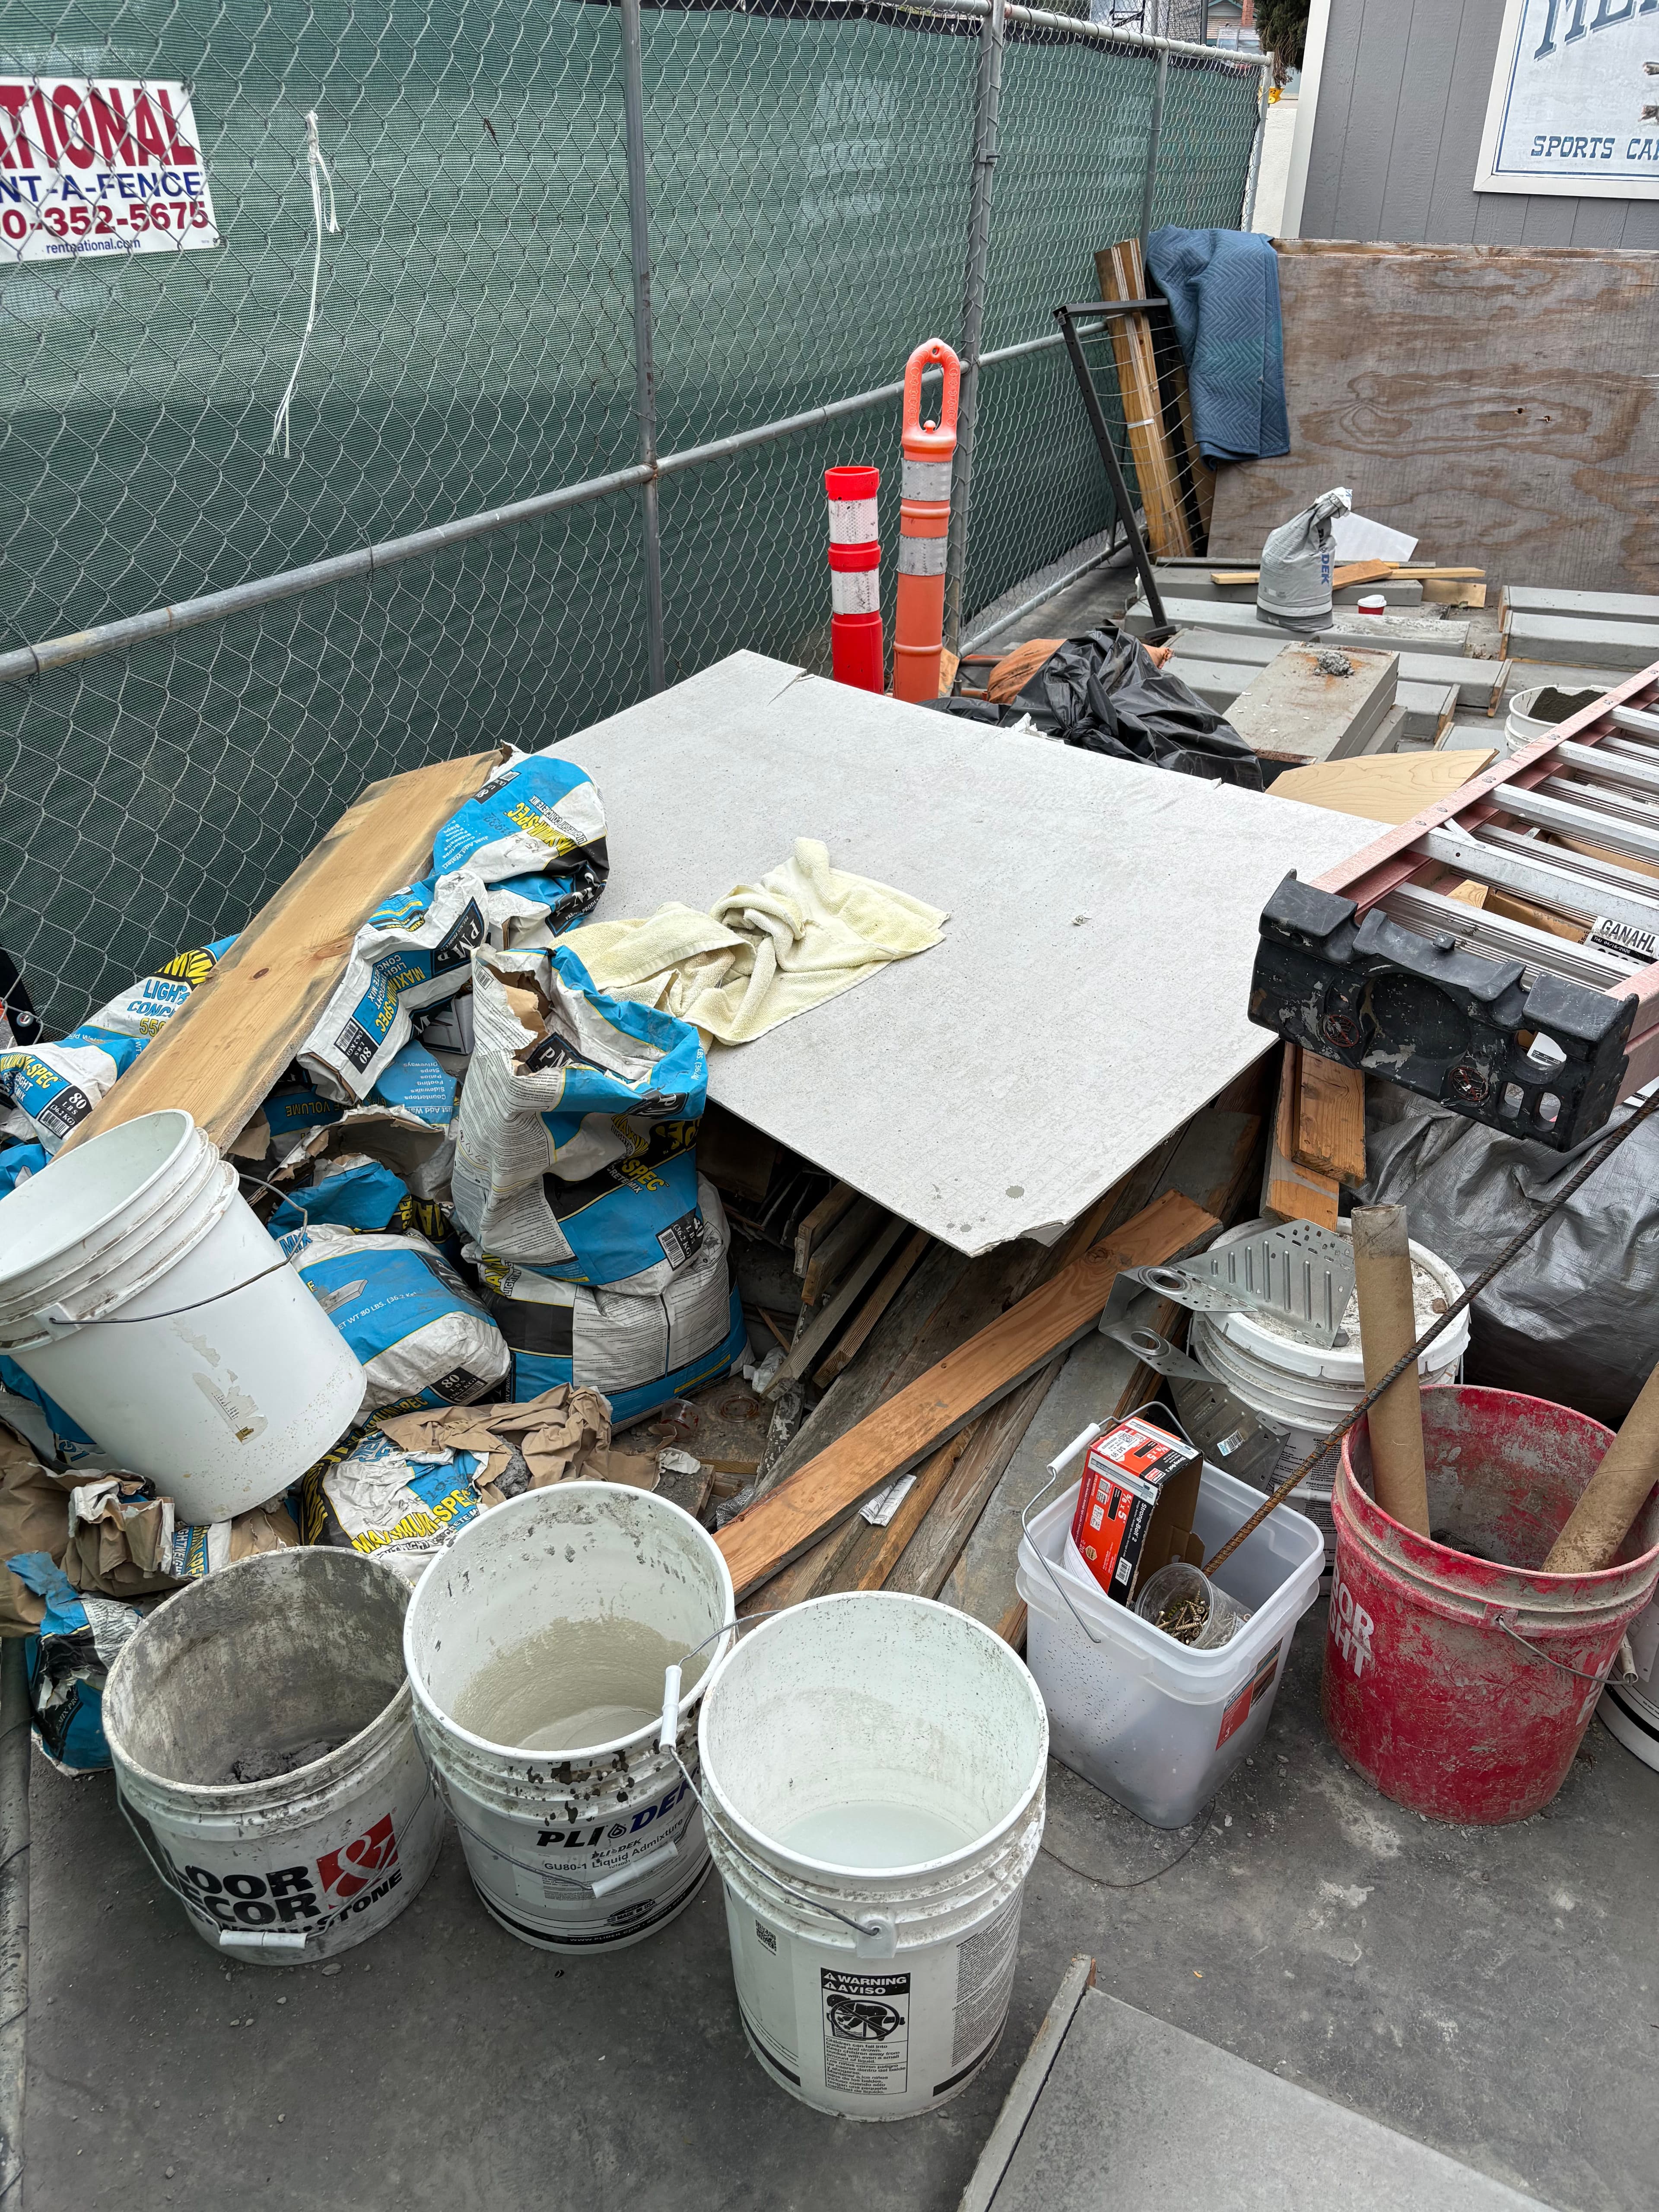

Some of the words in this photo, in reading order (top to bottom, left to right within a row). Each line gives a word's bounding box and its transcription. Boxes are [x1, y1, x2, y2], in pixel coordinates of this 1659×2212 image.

[1531, 136, 1615, 159] SPORTS
[0, 201, 209, 239] 0-352-5675
[46, 238, 140, 254] rentnational.com
[1321, 553, 1330, 584] DEK
[442, 836, 475, 859] Countertops
[444, 832, 472, 852] Sidewalks
[463, 842, 474, 855] Add
[437, 919, 480, 961] PMP
[1600, 919, 1656, 954] GANAHL
[367, 985, 379, 1002] MIX
[359, 1047, 372, 1065] 80
[62, 1101, 78, 1115] LBS
[69, 1092, 87, 1109] 80
[285, 1101, 331, 1117] VOLUME
[62, 1114, 76, 1126] KG)
[626, 1180, 644, 1195] MIX
[347, 1313, 360, 1324] WT
[359, 1307, 371, 1317] 80
[371, 1301, 387, 1313] LBS.
[387, 1291, 405, 1305] (36.2
[441, 1374, 461, 1389] 80
[1135, 1502, 1147, 1536] Strong-Bolt
[537, 1826, 605, 1848] PLI
[592, 1852, 629, 1869] Liquid
[632, 1818, 683, 1856] Admixture
[617, 1837, 642, 1853] DEK
[317, 1868, 403, 1931] STONE
[617, 1911, 635, 1920] MADE
[643, 1900, 657, 1910] USA
[838, 1975, 907, 1986] WARNING
[838, 1984, 886, 1994] AVISO
